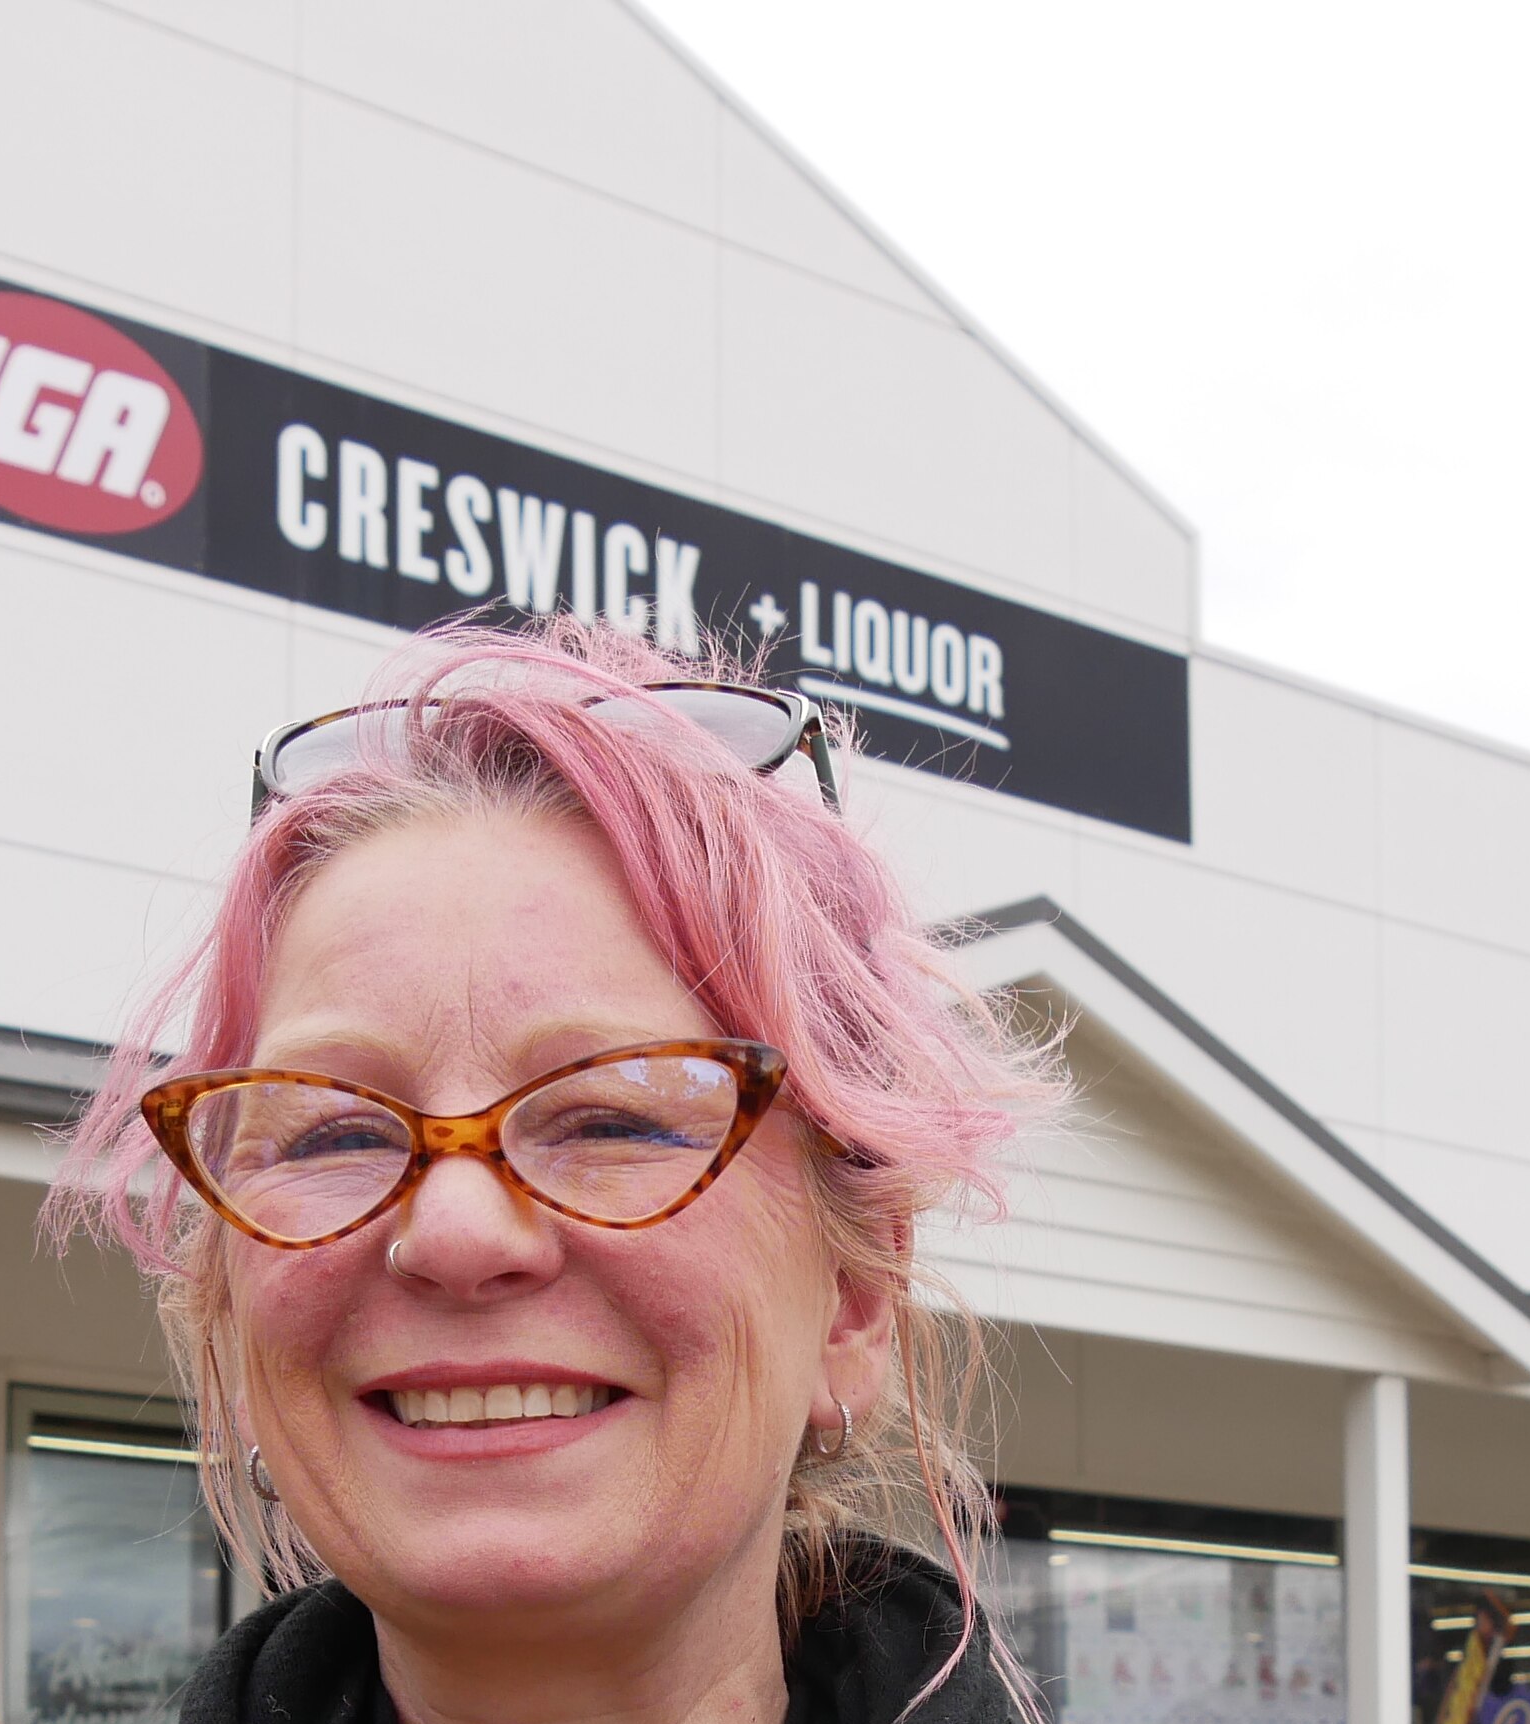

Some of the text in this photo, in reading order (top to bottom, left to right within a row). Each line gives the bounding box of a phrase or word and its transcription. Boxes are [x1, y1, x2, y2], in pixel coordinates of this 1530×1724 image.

[275, 423, 1007, 721] CRESWICK + LIQUOR
